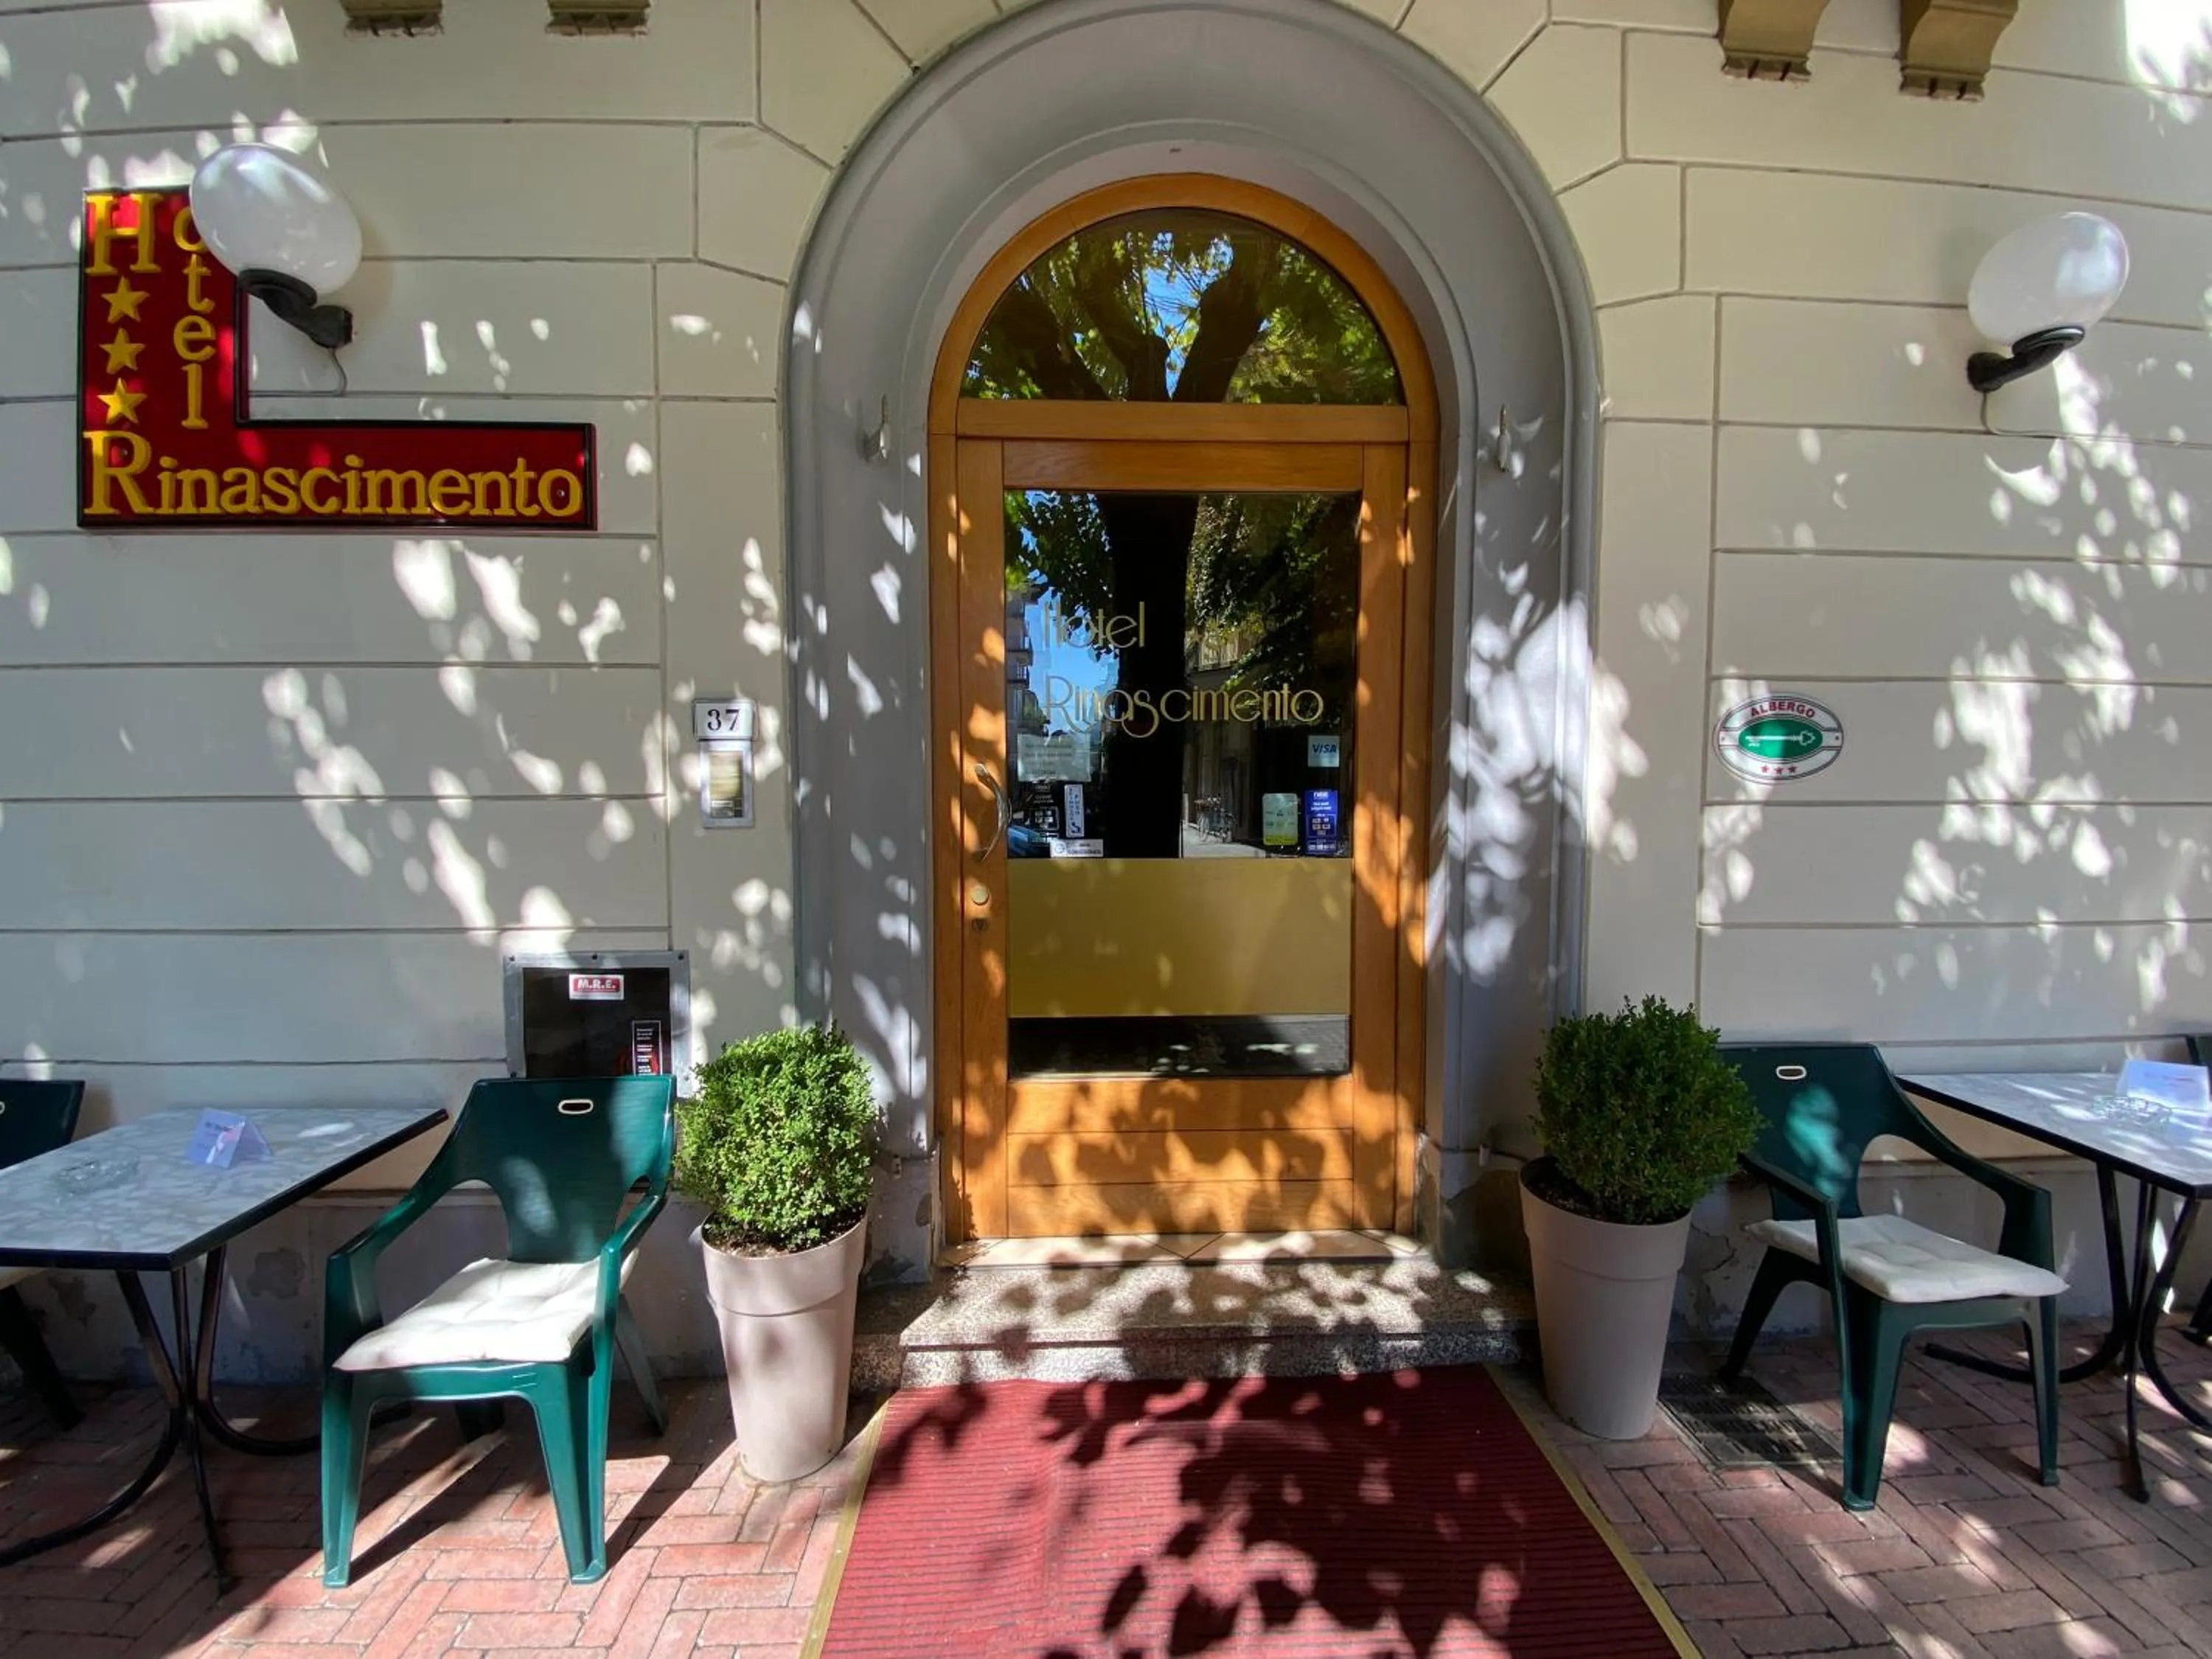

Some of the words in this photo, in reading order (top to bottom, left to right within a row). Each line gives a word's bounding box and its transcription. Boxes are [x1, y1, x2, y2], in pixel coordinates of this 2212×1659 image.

[84, 431, 583, 516] Rinascimento
[1043, 601, 1145, 649] Hotel
[1046, 674, 1324, 738] Rinascimento
[1750, 700, 1815, 718] ALBERGO
[707, 709, 740, 731] 37
[1312, 743, 1337, 753] VISA
[577, 978, 616, 989] M.R.E.
